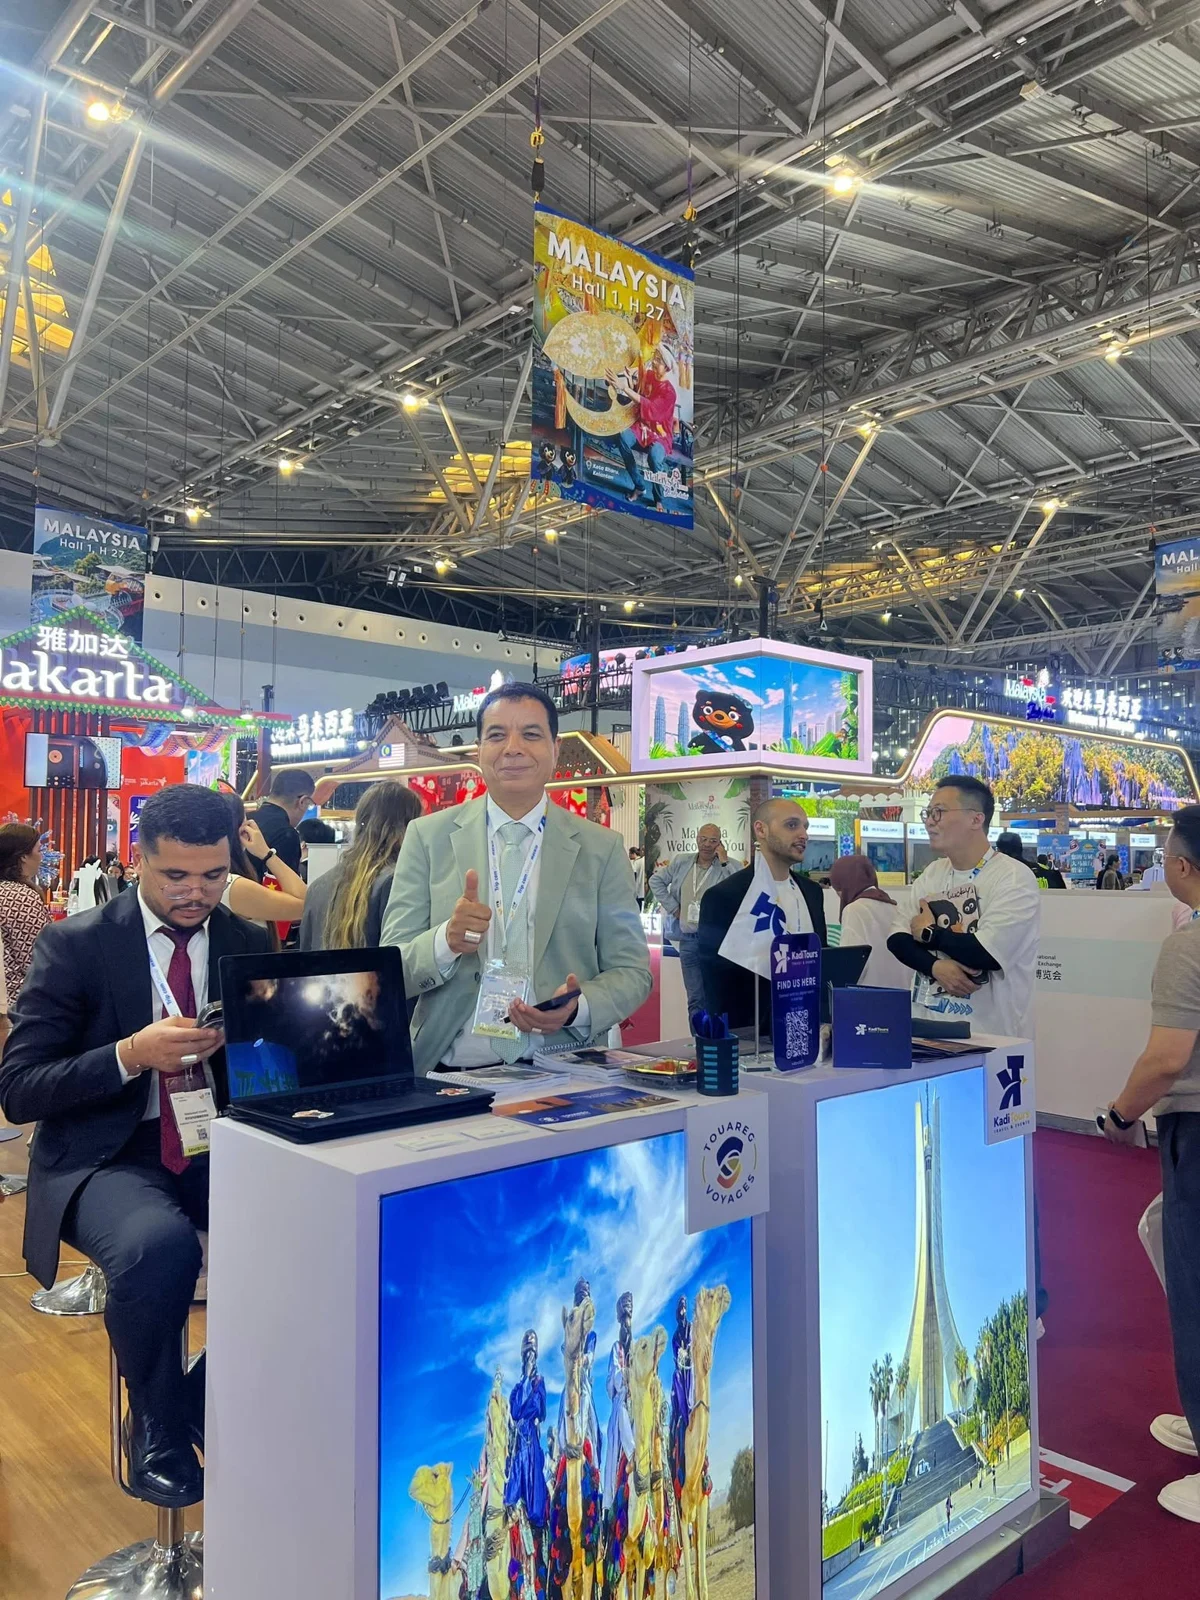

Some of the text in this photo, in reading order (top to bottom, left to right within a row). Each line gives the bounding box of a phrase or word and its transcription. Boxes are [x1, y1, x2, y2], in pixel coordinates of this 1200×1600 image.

[547, 231, 686, 310] MALAYSIA
[572, 273, 664, 321] Hall 1, H 27
[43, 518, 142, 551] MALAYSIA
[60, 538, 124, 559] Hall 1, H 27
[1176, 563, 1198, 574] Hall
[36, 625, 130, 659] 雅加达
[724, 840, 745, 852] You
[777, 977, 816, 990] FIND US HERE
[704, 1122, 755, 1151] TOUAREG
[706, 1174, 755, 1204] VOYAGES
